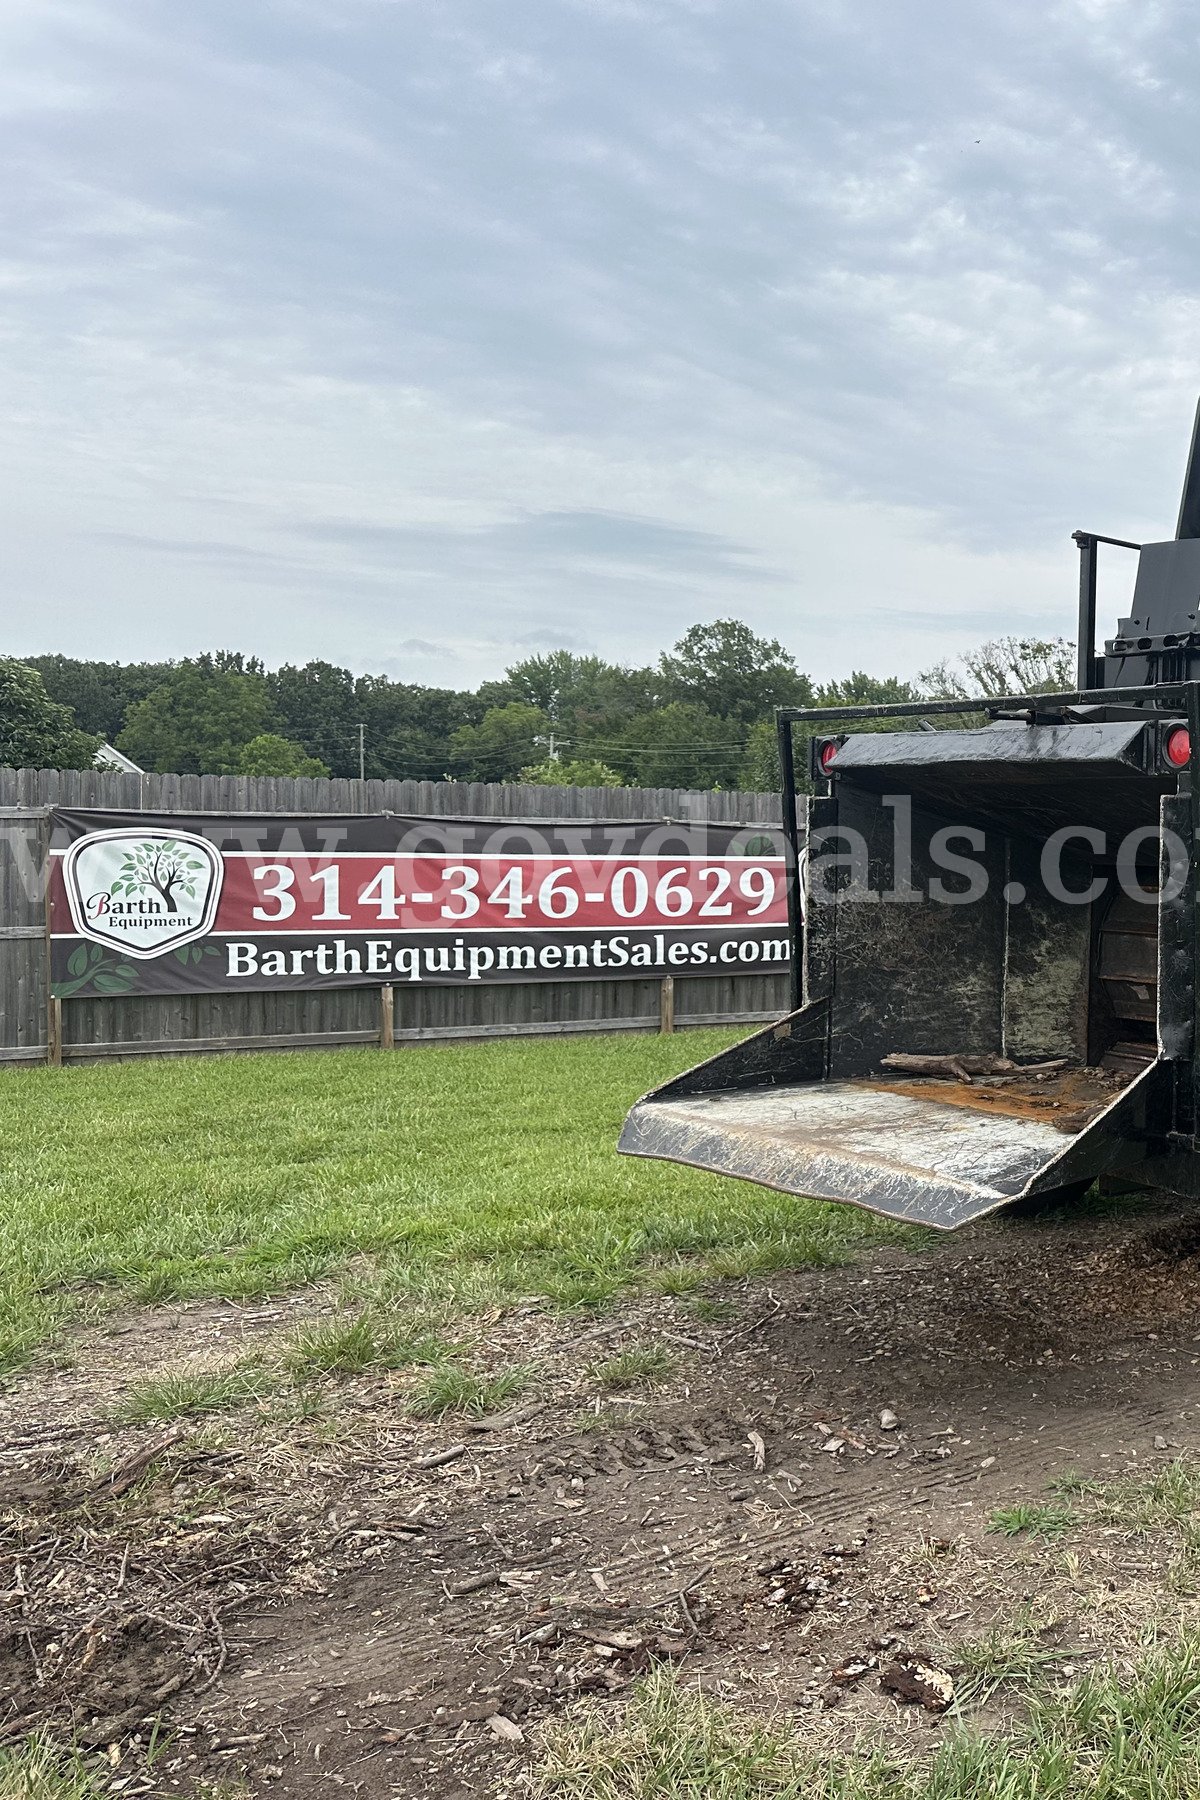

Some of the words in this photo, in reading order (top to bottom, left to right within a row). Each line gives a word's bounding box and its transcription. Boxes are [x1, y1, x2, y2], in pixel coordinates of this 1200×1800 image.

[86, 891, 162, 921] Barth
[252, 865, 776, 922] 314-346-0629
[108, 915, 193, 930] Equipment
[225, 934, 791, 982] BarthEquipmentSales.com
